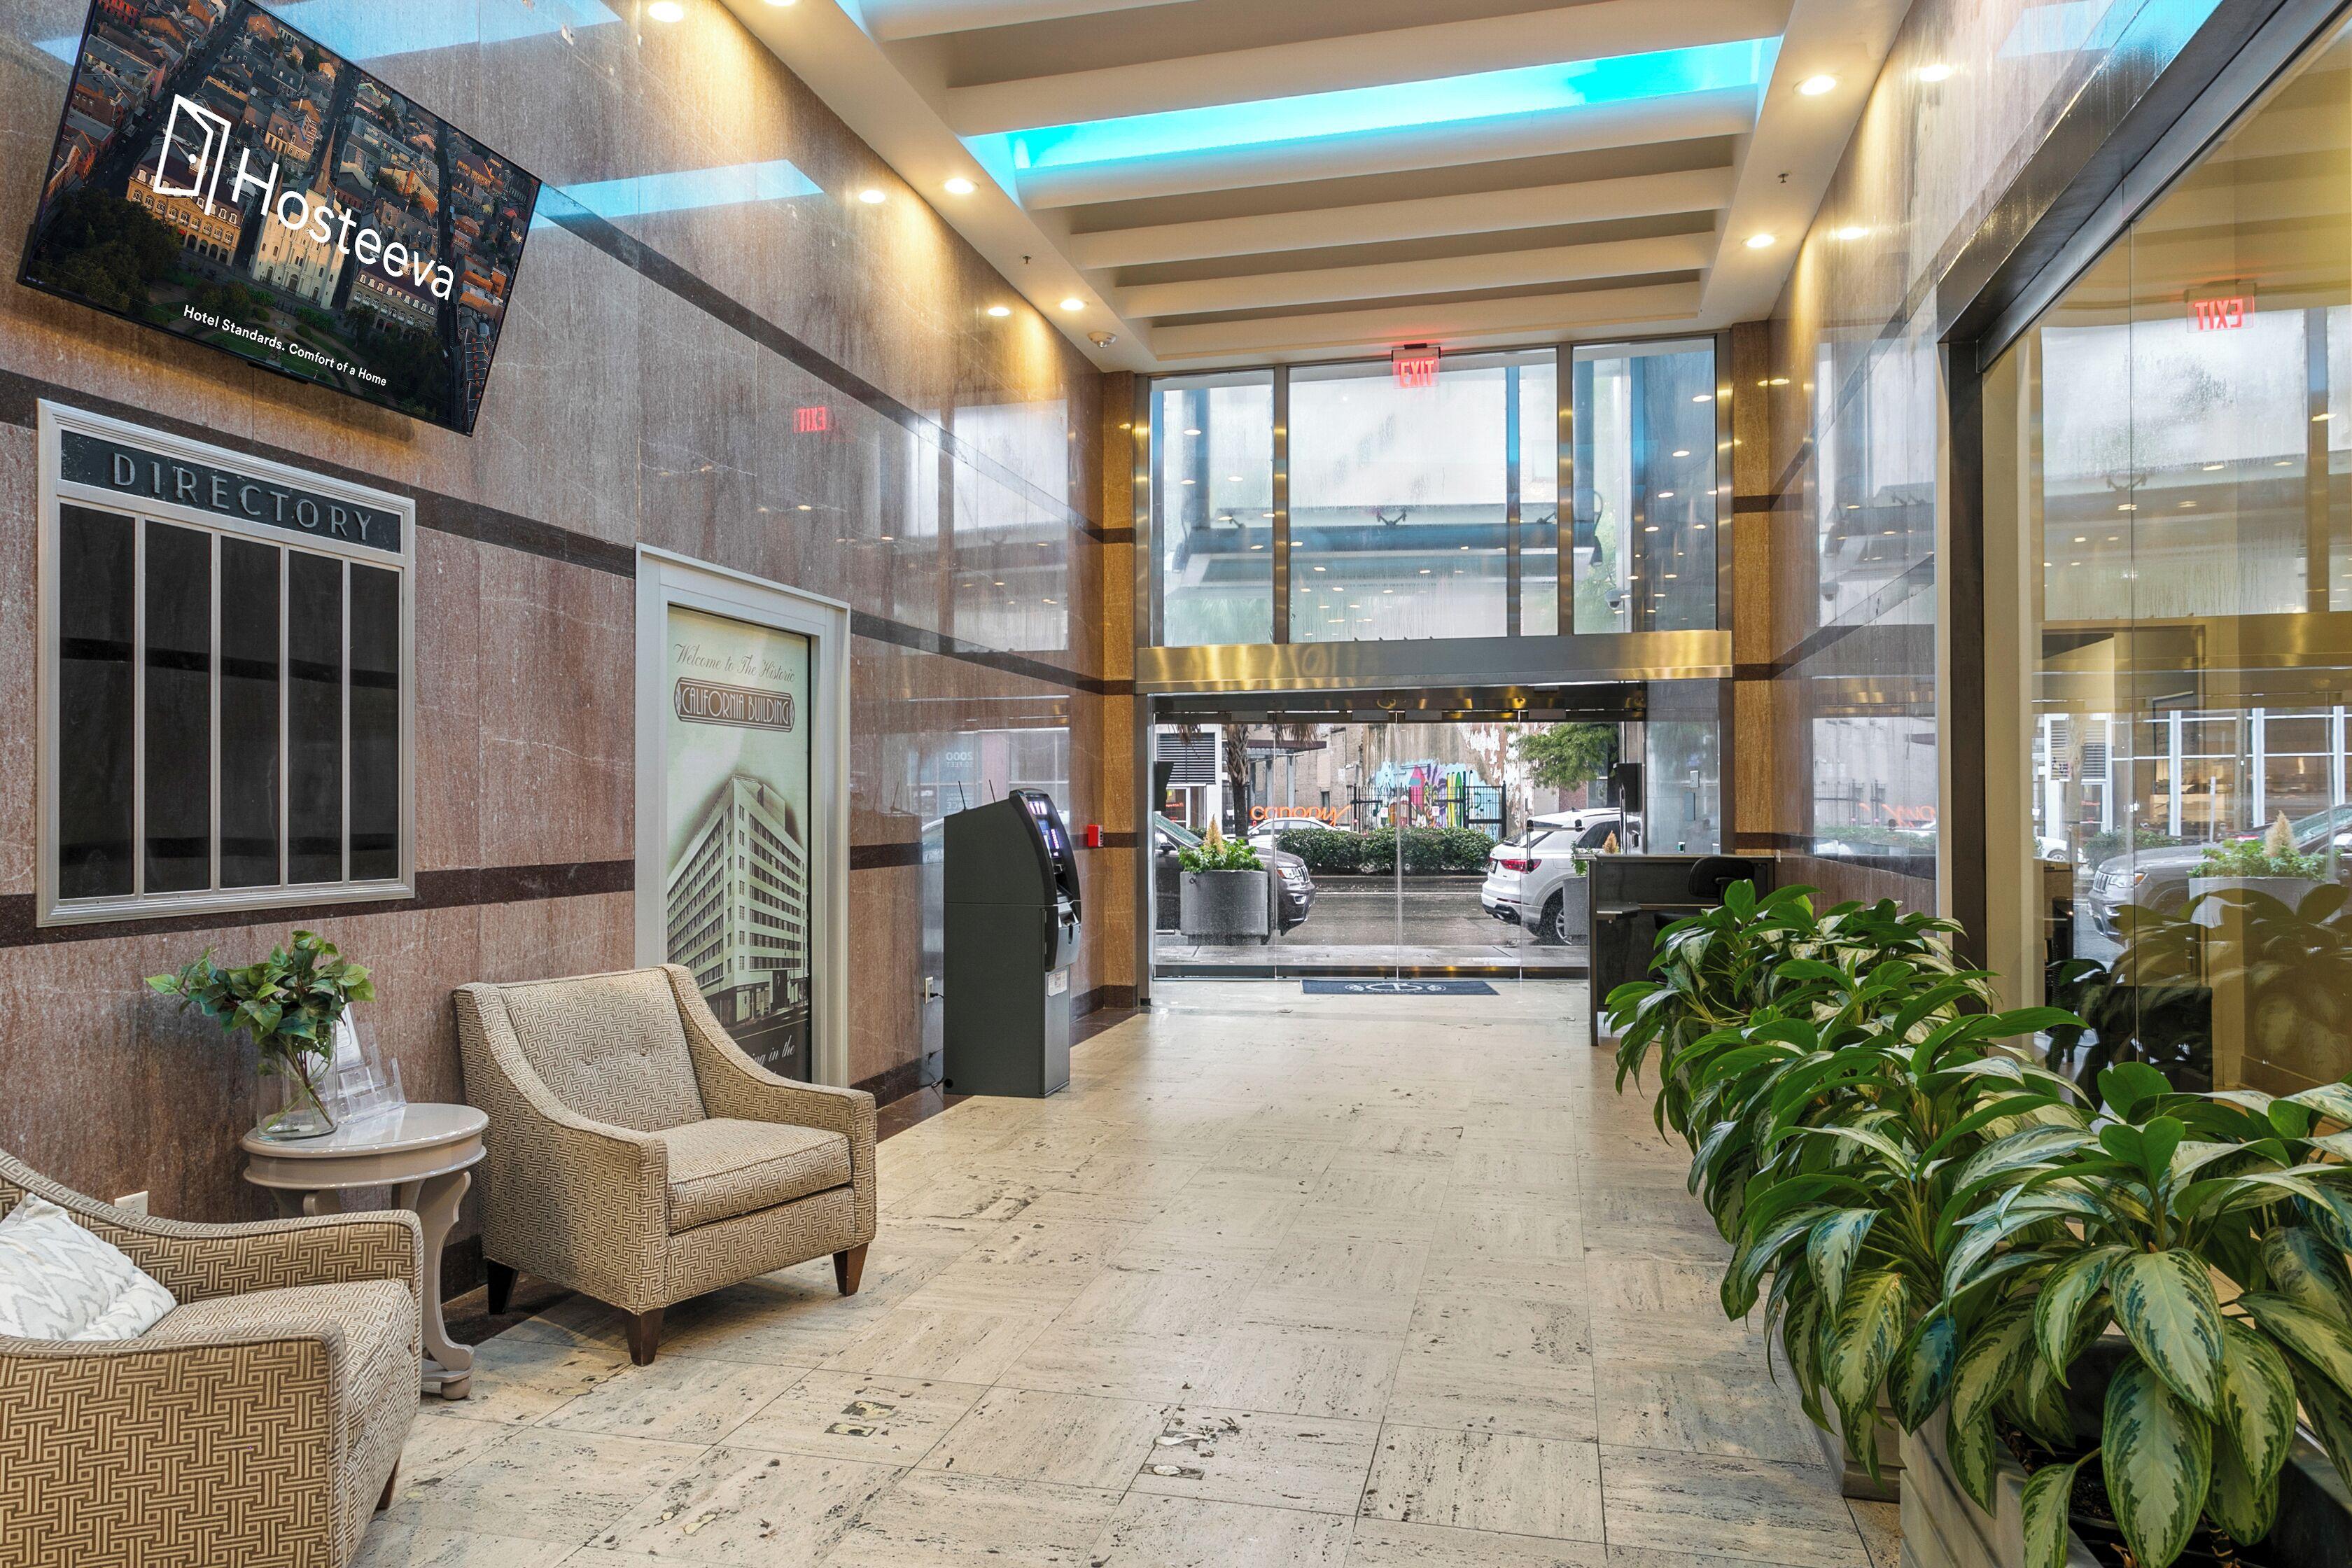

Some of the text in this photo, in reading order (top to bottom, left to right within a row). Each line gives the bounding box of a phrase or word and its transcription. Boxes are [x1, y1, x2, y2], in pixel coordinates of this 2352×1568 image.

[231, 147, 454, 301] Hosteeva
[183, 304, 386, 386] Hotel Standards. Comfort of a Home
[1400, 360, 1434, 388] EXIT
[113, 452, 372, 541] DIRECTORY
[673, 643, 796, 682] Welcome to The Historic
[681, 687, 790, 724] CALIFORNIA BUILDING
[1250, 805, 1351, 827] canopy
[769, 1047, 779, 1062] in
[782, 1035, 795, 1058] the
